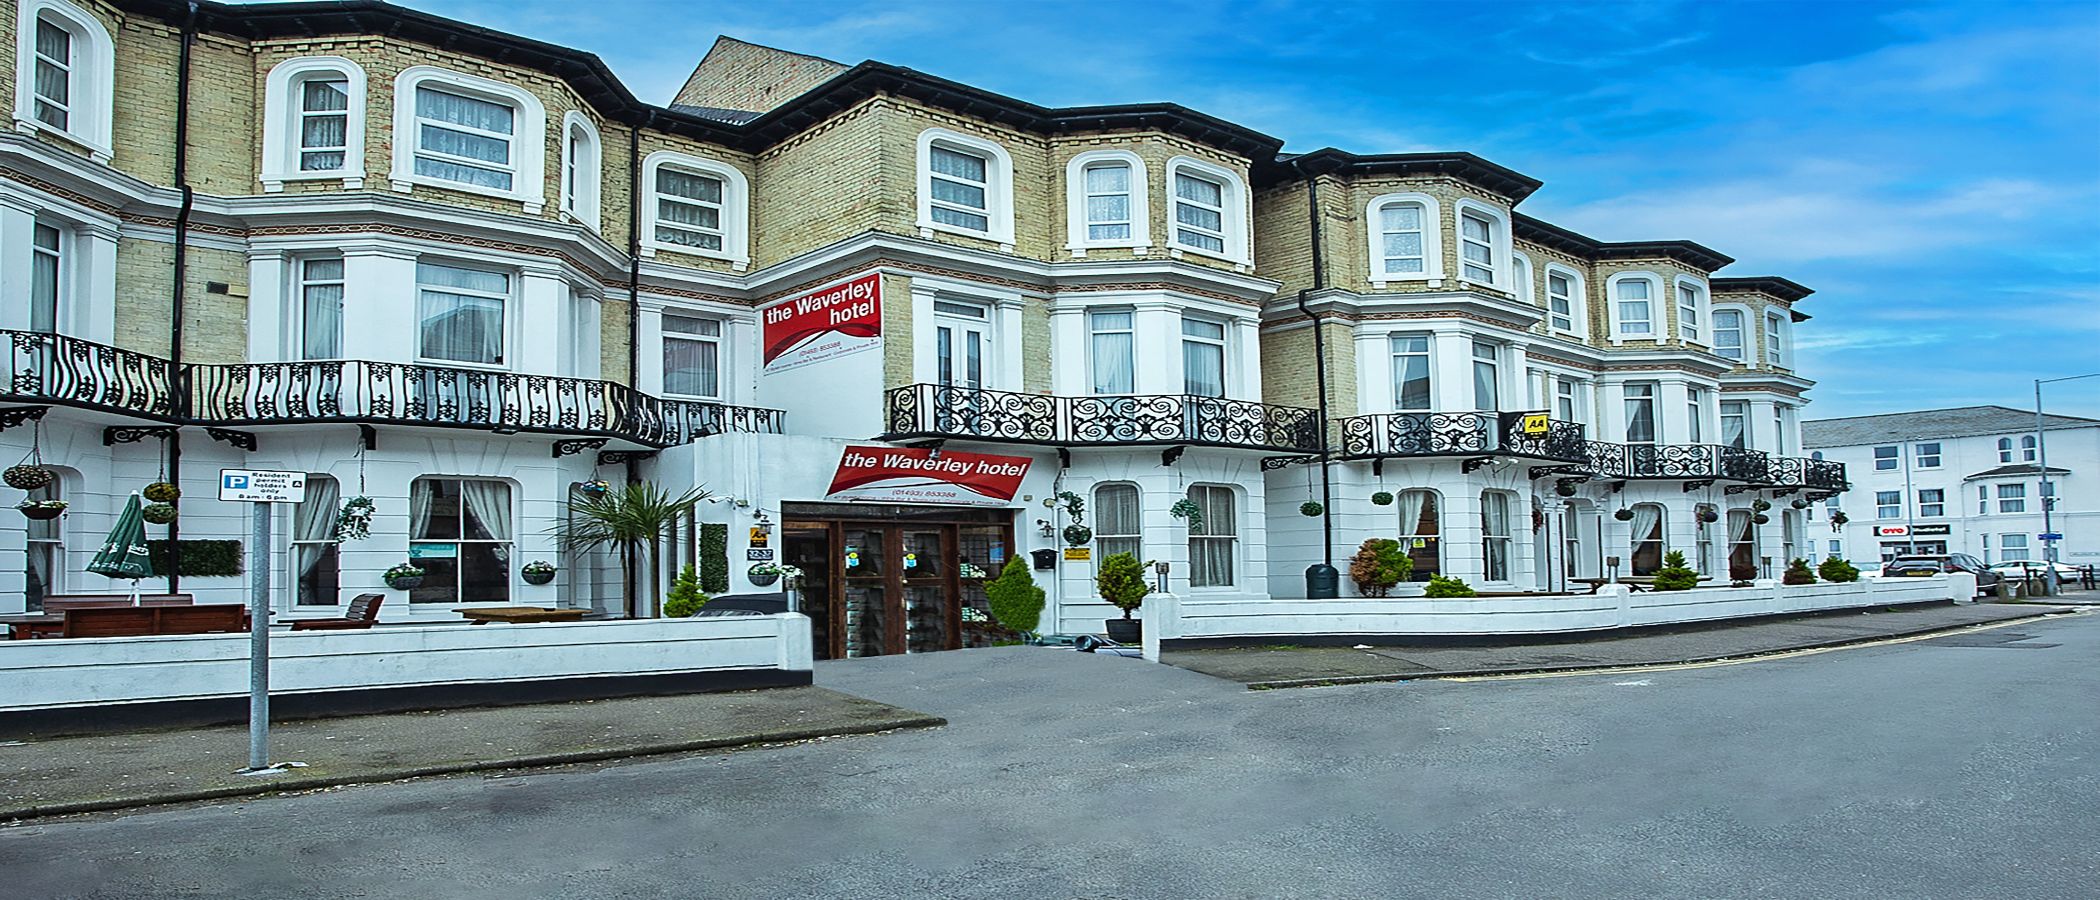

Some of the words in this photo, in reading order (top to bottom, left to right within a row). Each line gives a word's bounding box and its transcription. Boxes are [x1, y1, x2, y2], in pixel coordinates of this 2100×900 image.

[767, 307, 792, 324] the
[796, 281, 875, 315] Waverley
[830, 297, 874, 325] hotel
[1528, 420, 1544, 428] AA
[844, 453, 877, 468] the
[883, 454, 974, 476] Waverley
[976, 460, 1026, 477] hotel
[230, 477, 245, 487] P
